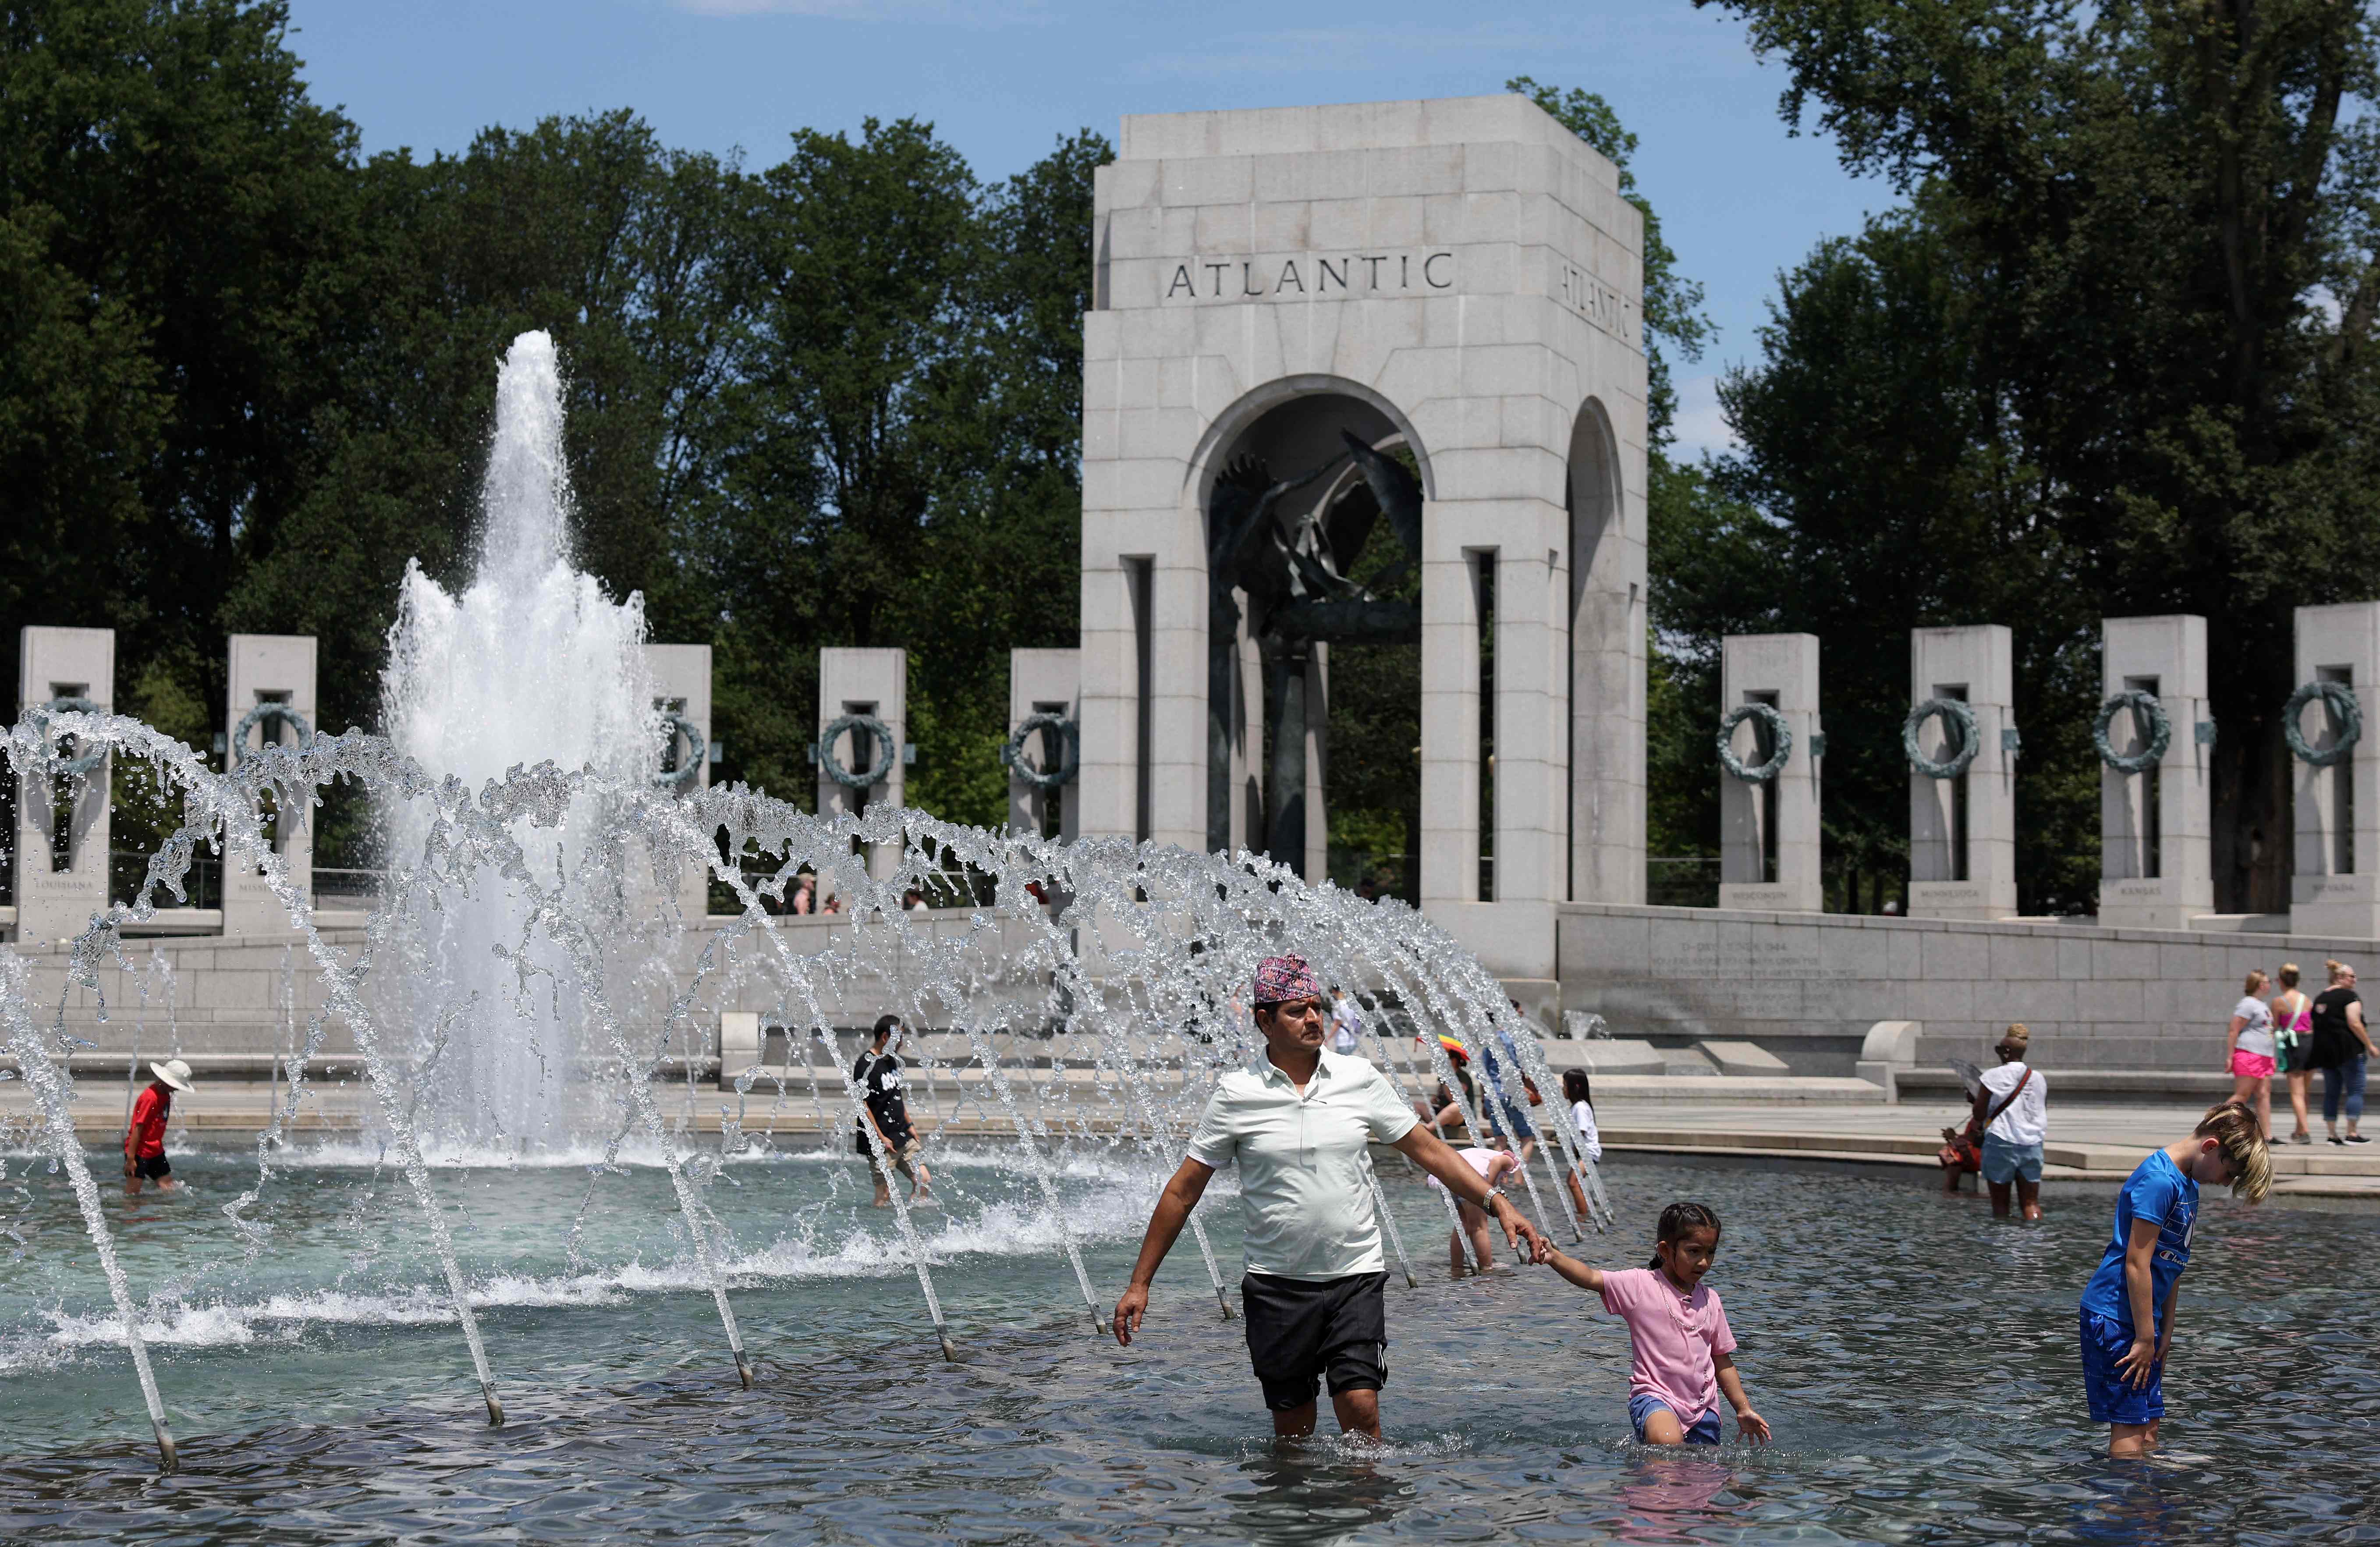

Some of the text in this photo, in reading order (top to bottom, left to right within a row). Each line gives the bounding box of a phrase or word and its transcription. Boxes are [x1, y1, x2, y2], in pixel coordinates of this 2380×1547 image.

[1166, 253, 1452, 298] ATLANTIC
[1562, 265, 1629, 337] ATLANTIC
[35, 880, 93, 890] LOUISIANA
[2120, 886, 2161, 896] KANSAS
